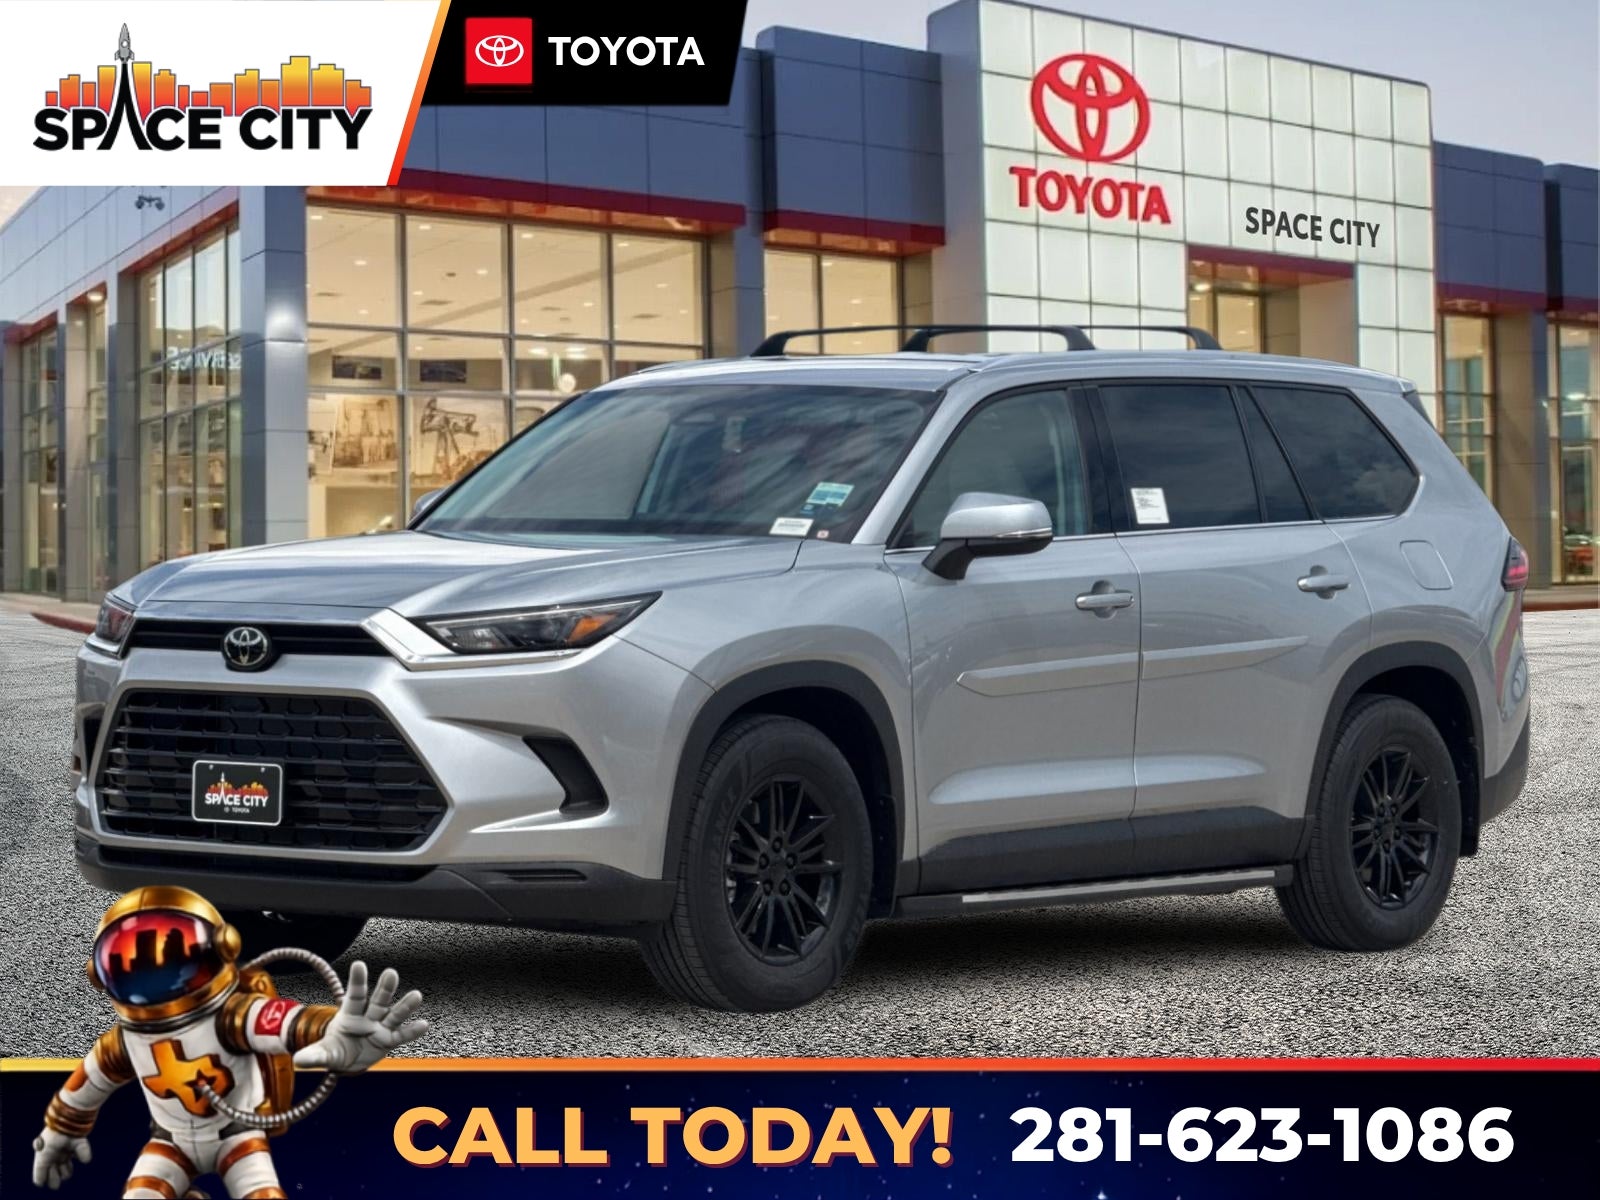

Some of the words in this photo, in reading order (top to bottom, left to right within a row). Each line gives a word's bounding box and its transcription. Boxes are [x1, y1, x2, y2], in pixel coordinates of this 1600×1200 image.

[1009, 165, 1171, 224] TOYOTA
[1245, 206, 1323, 242] SPACE
[1329, 217, 1381, 248] CITY
[204, 789, 241, 806] SPACE
[242, 794, 269, 807] CITY
